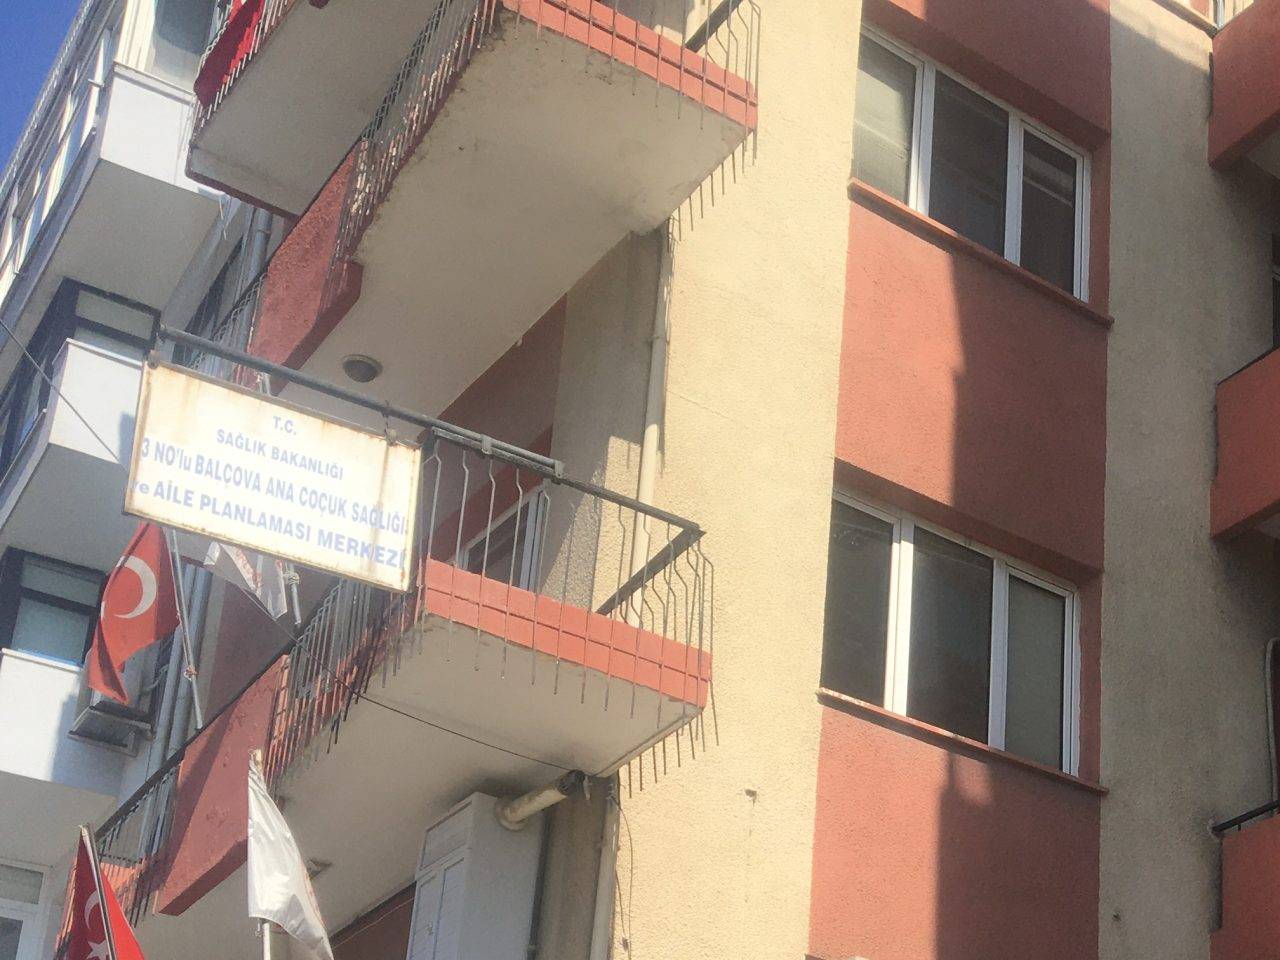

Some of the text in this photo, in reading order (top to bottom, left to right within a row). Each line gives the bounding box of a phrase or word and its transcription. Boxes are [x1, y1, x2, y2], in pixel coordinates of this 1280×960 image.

[217, 428, 344, 480] SAĞLIK BAKANLIĞI
[272, 416, 297, 435] T.C.
[141, 437, 150, 458] 3
[195, 454, 261, 493] BALÇOVA
[266, 477, 294, 502] ANA
[153, 480, 195, 508] AİLE
[200, 494, 311, 542] PLANLAMASI
